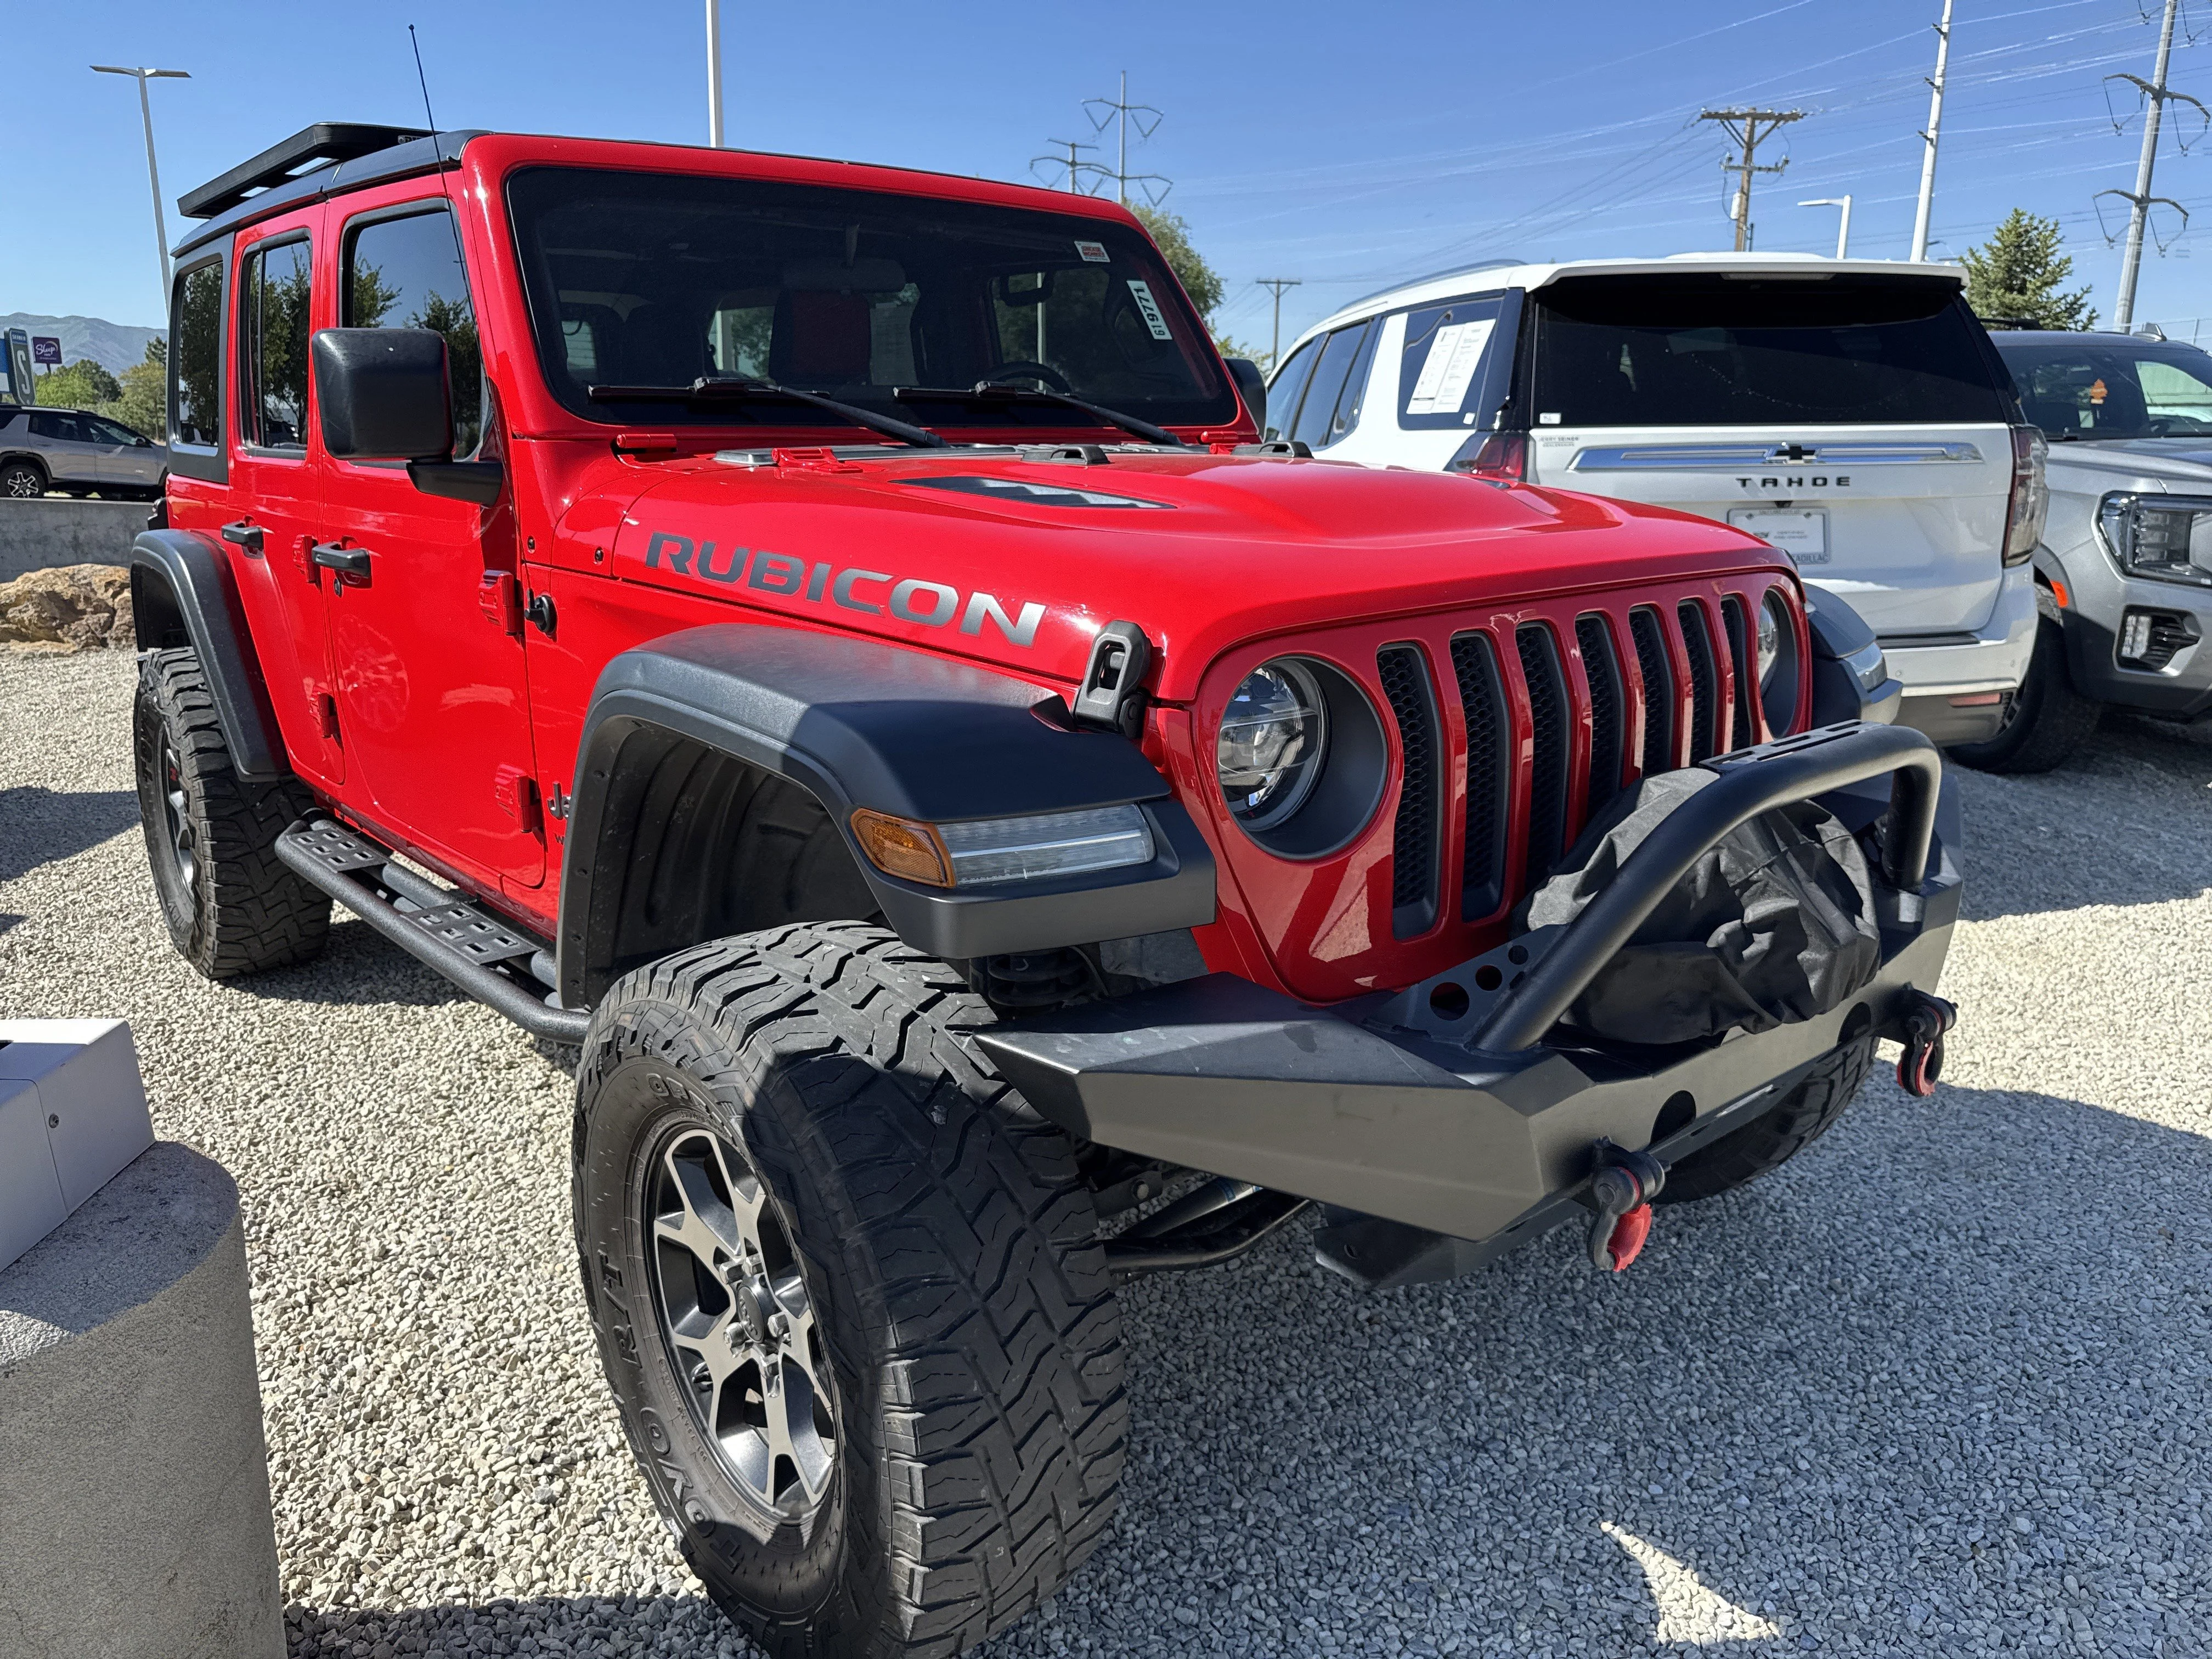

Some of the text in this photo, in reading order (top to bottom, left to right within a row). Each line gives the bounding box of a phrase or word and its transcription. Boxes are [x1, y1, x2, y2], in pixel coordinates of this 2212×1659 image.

[36, 343, 55, 355] Sleep
[1736, 476, 1852, 488] TAHOE
[645, 531, 1047, 648] RUBICON
[640, 1407, 742, 1576] TOYO
